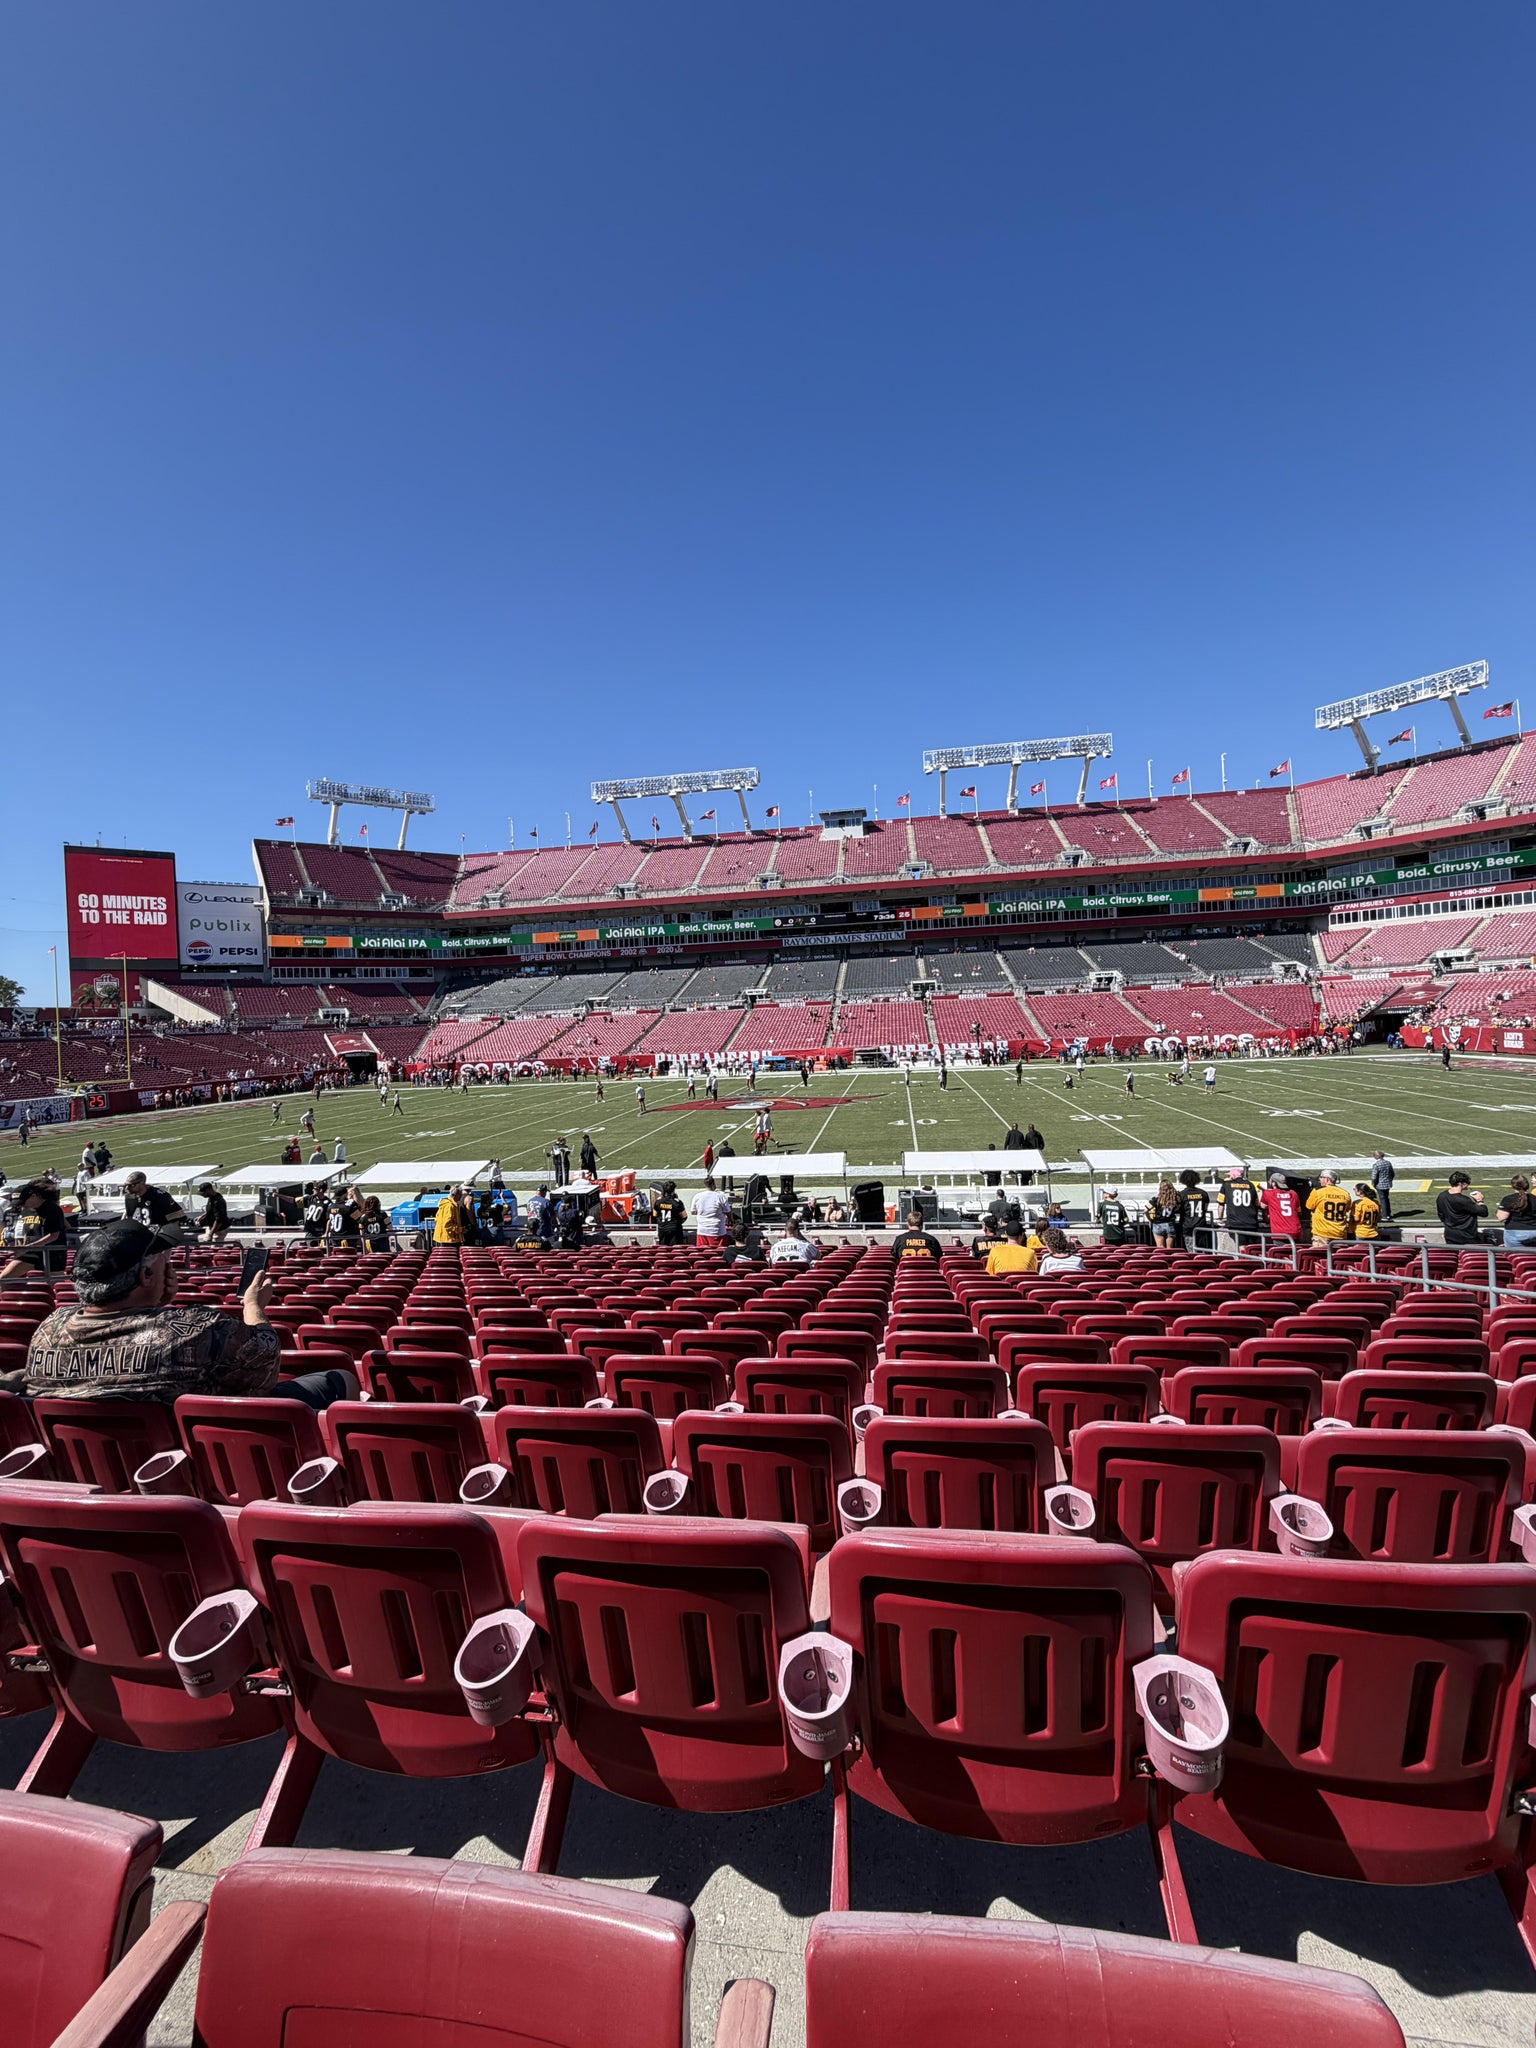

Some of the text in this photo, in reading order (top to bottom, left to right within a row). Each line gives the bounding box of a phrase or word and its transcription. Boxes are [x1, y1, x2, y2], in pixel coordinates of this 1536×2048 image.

[1397, 853, 1524, 880] Bold. Citrusy. Beer.
[1293, 874, 1376, 895] Jai Alai IPA
[78, 893, 167, 911] 60 MINUTES
[204, 895, 254, 903] LEXUS
[1082, 893, 1172, 906] Bold. Citrusy. Beer.
[997, 900, 1066, 913] Jai Alai IPA
[79, 909, 167, 925] TO THE RAID
[190, 918, 252, 931] Publix
[679, 920, 756, 933] Bold. Citrusy. Beer.
[606, 926, 665, 938] Jai Alai IPA
[783, 931, 905, 946] RAYMOND JAMES STADIUM
[360, 937, 427, 948] Jai Alai IPA
[442, 936, 513, 947] Bold. Citrusy. Beer.
[219, 947, 258, 955] PEPSI
[520, 954, 544, 962] SUPER
[545, 952, 567, 961] BOWL
[569, 950, 612, 959] CHAMPIONS
[88, 1096, 104, 1109] 25
[1069, 1114, 1124, 1122] 30
[1259, 1109, 1324, 1117] 20
[888, 1118, 938, 1126] 40
[1233, 1189, 1251, 1207] 80
[306, 1204, 323, 1222] 90
[1189, 1200, 1203, 1217] 14
[1280, 1200, 1292, 1217] 5
[1324, 1202, 1347, 1221] 88
[660, 1209, 672, 1222] 14
[1106, 1211, 1120, 1225] 12
[367, 1222, 380, 1234] 90
[906, 1238, 925, 1247] PARKER
[32, 1345, 150, 1377] POLAMALU
